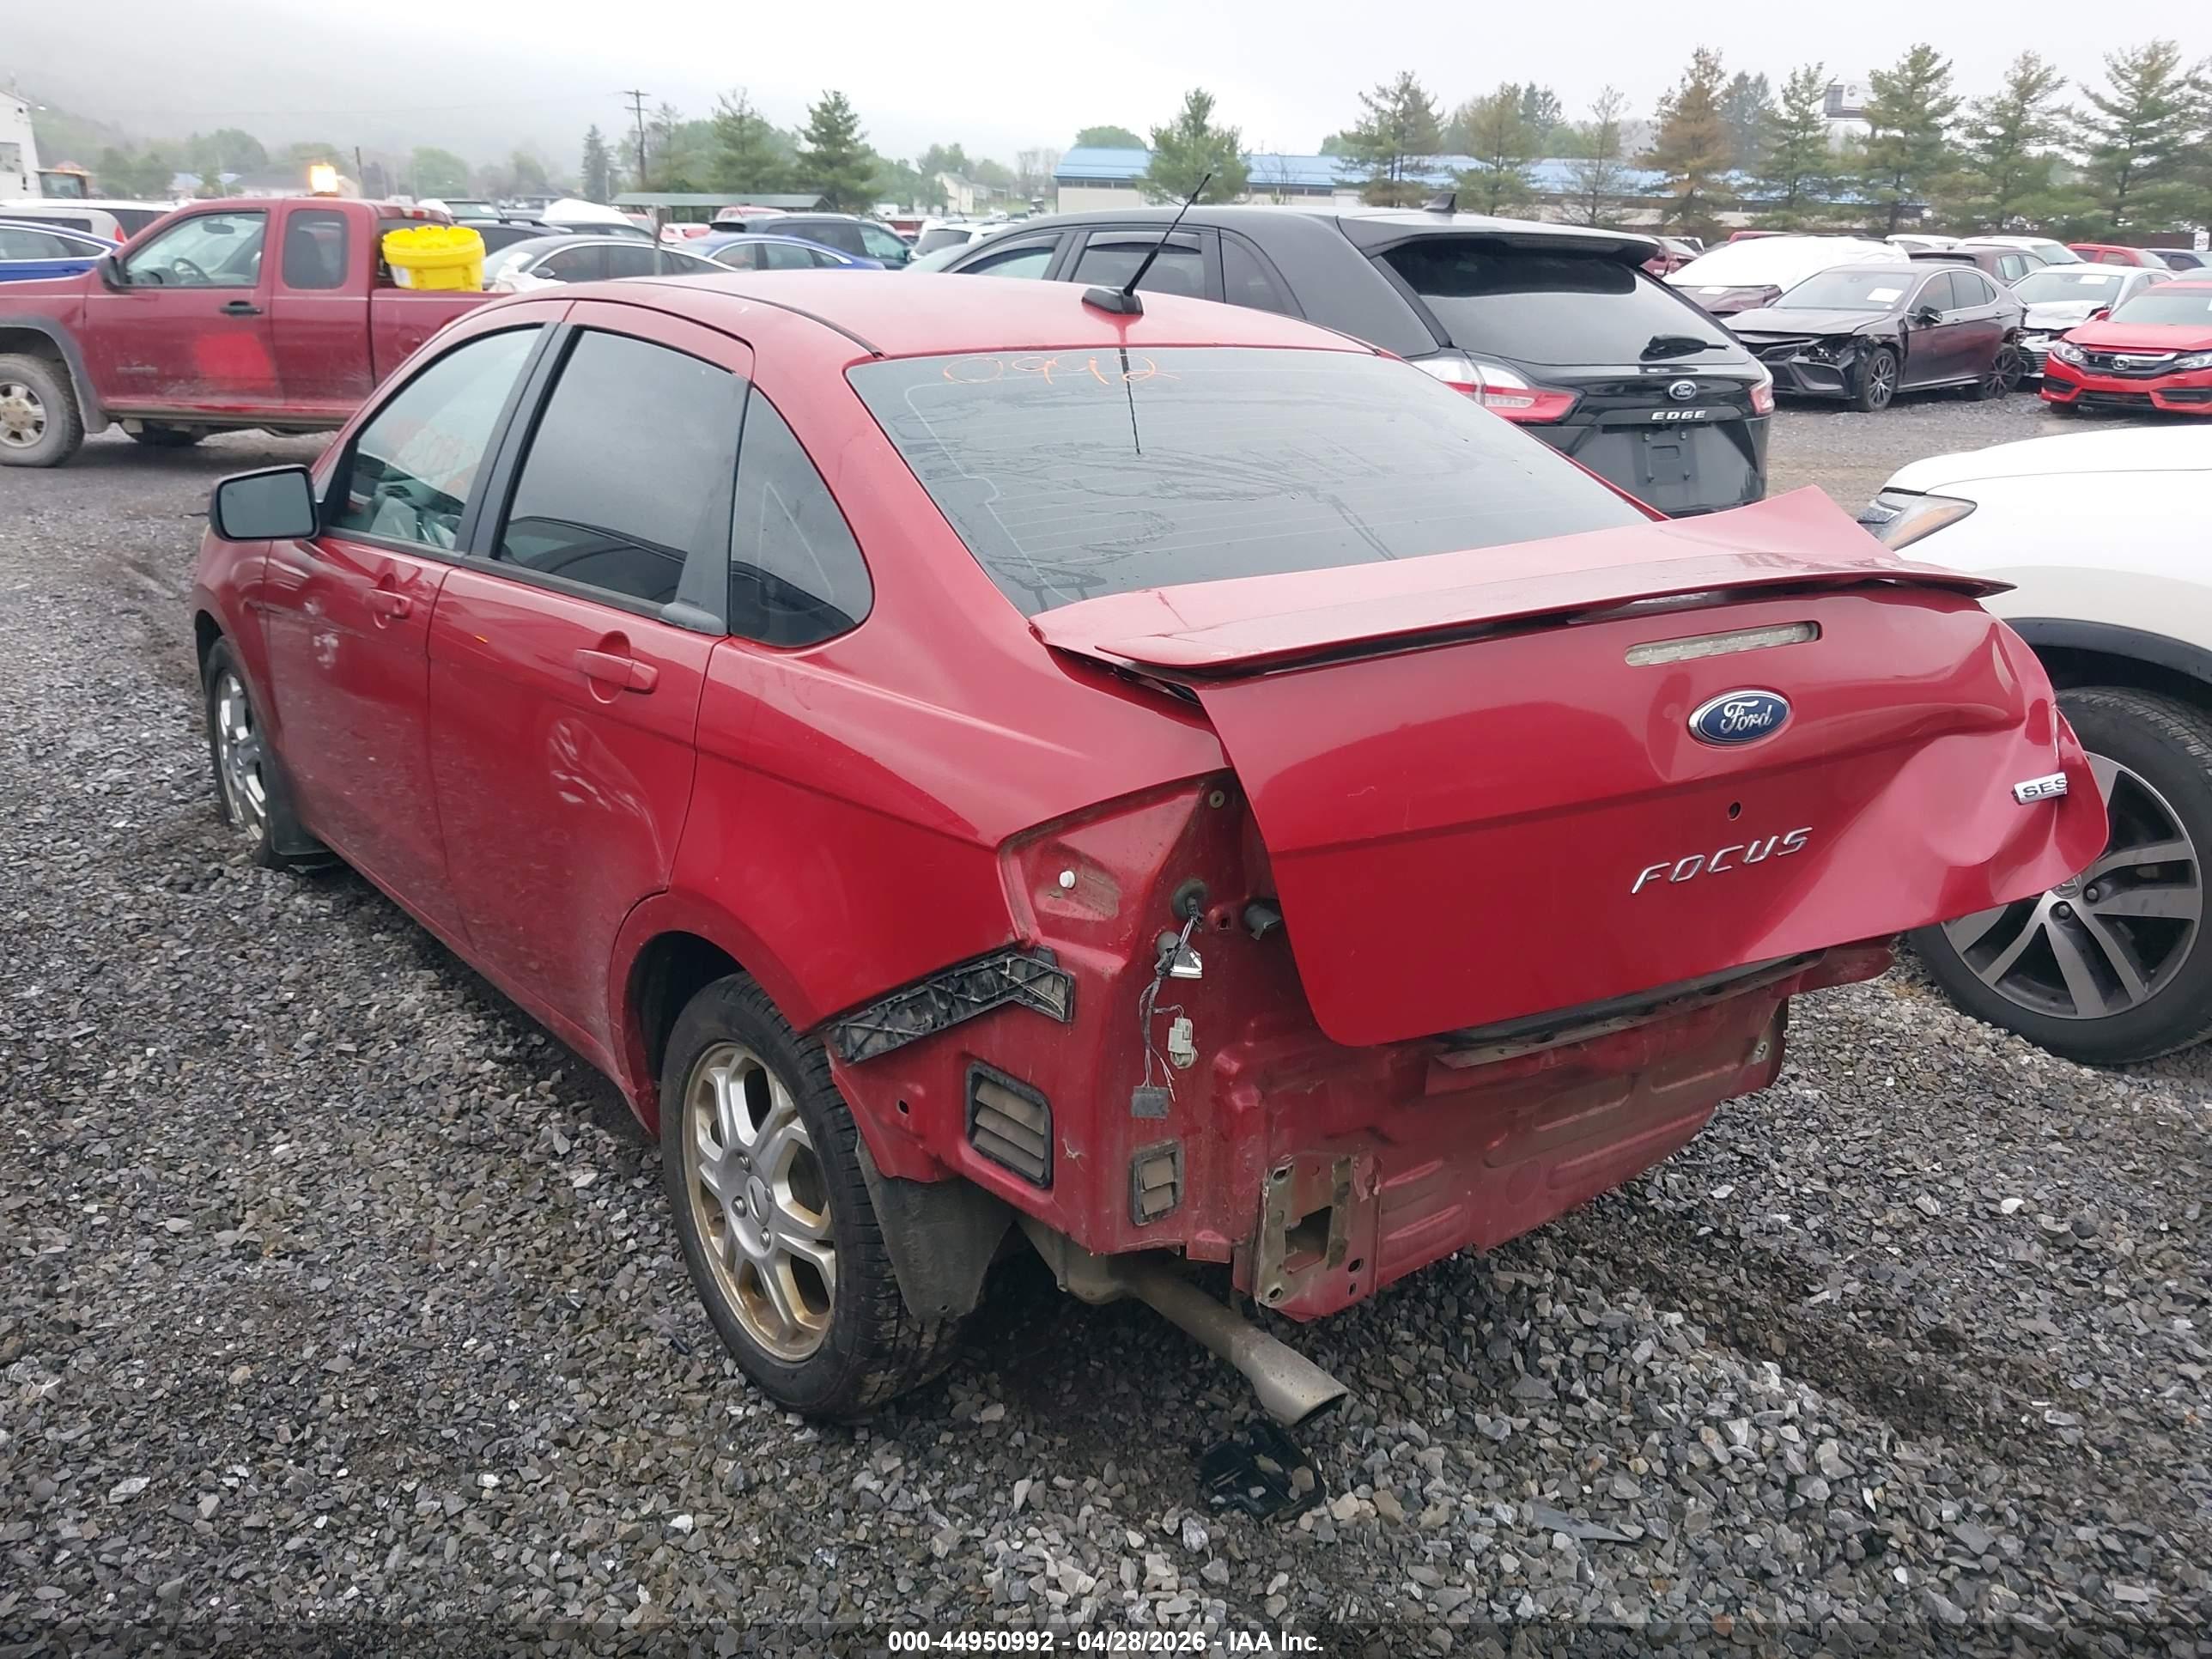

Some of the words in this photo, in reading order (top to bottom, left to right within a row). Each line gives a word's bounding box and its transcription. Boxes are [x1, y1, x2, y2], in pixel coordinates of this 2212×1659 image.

[944, 353, 1182, 385] 0992
[1676, 384, 1693, 396] Ford
[1651, 410, 1706, 421] EDGE
[1719, 700, 1773, 734] Ford
[2022, 777, 2068, 798] SES
[1631, 827, 1813, 894] FOCUS
